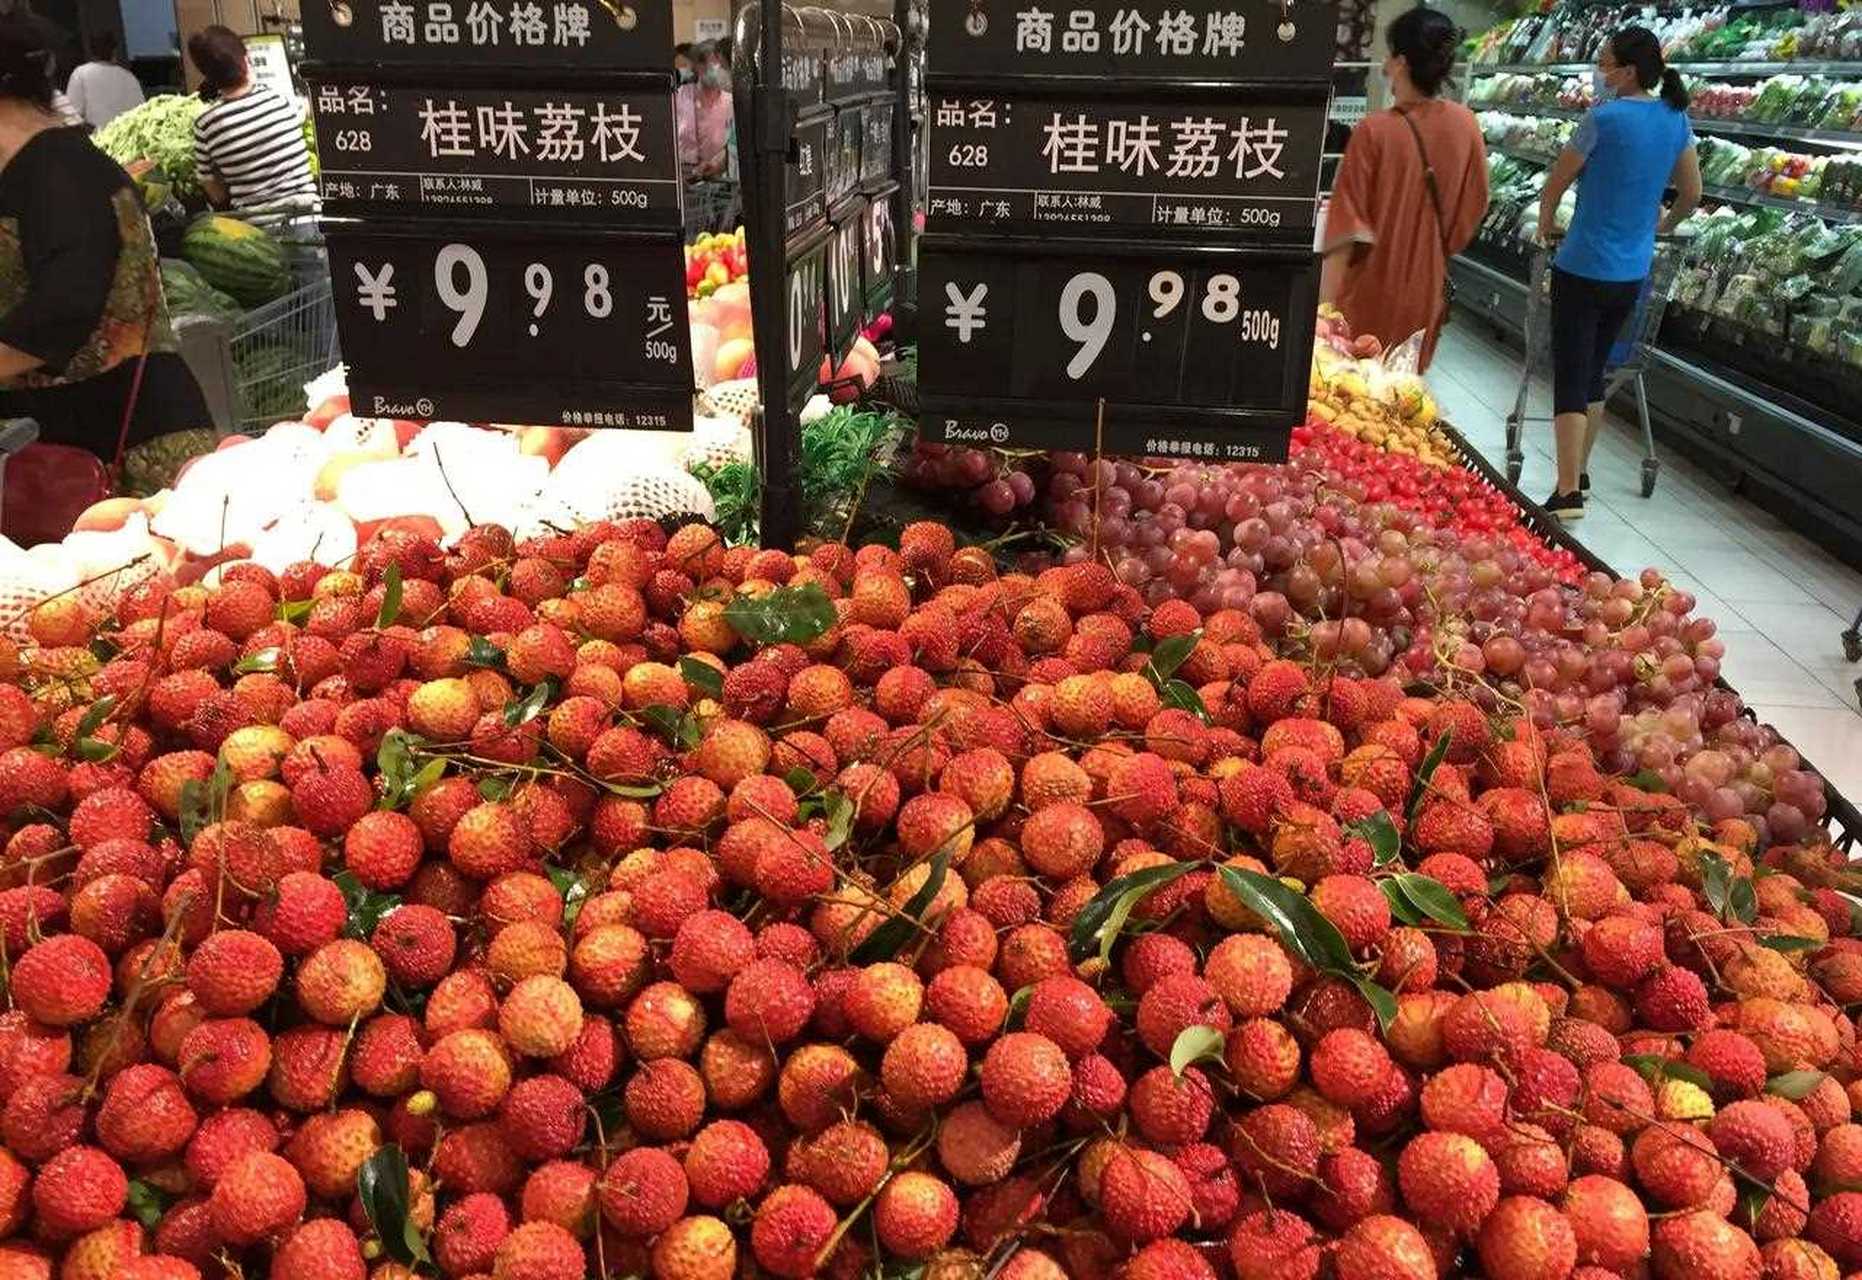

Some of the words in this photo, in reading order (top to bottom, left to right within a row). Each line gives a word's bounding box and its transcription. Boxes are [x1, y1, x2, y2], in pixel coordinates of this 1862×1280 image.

[379, 1, 591, 46] 商品价格牌
[1016, 7, 1245, 56] 商品价格牌
[335, 130, 371, 151] 628
[418, 99, 645, 162] 桂味荔枝
[1042, 112, 1289, 179] 桂味荔枝
[949, 145, 988, 166] 628
[611, 190, 647, 208] 500g
[1241, 310, 1280, 350] 500g
[636, 415, 666, 426] 12315
[1226, 445, 1259, 457] 12315
